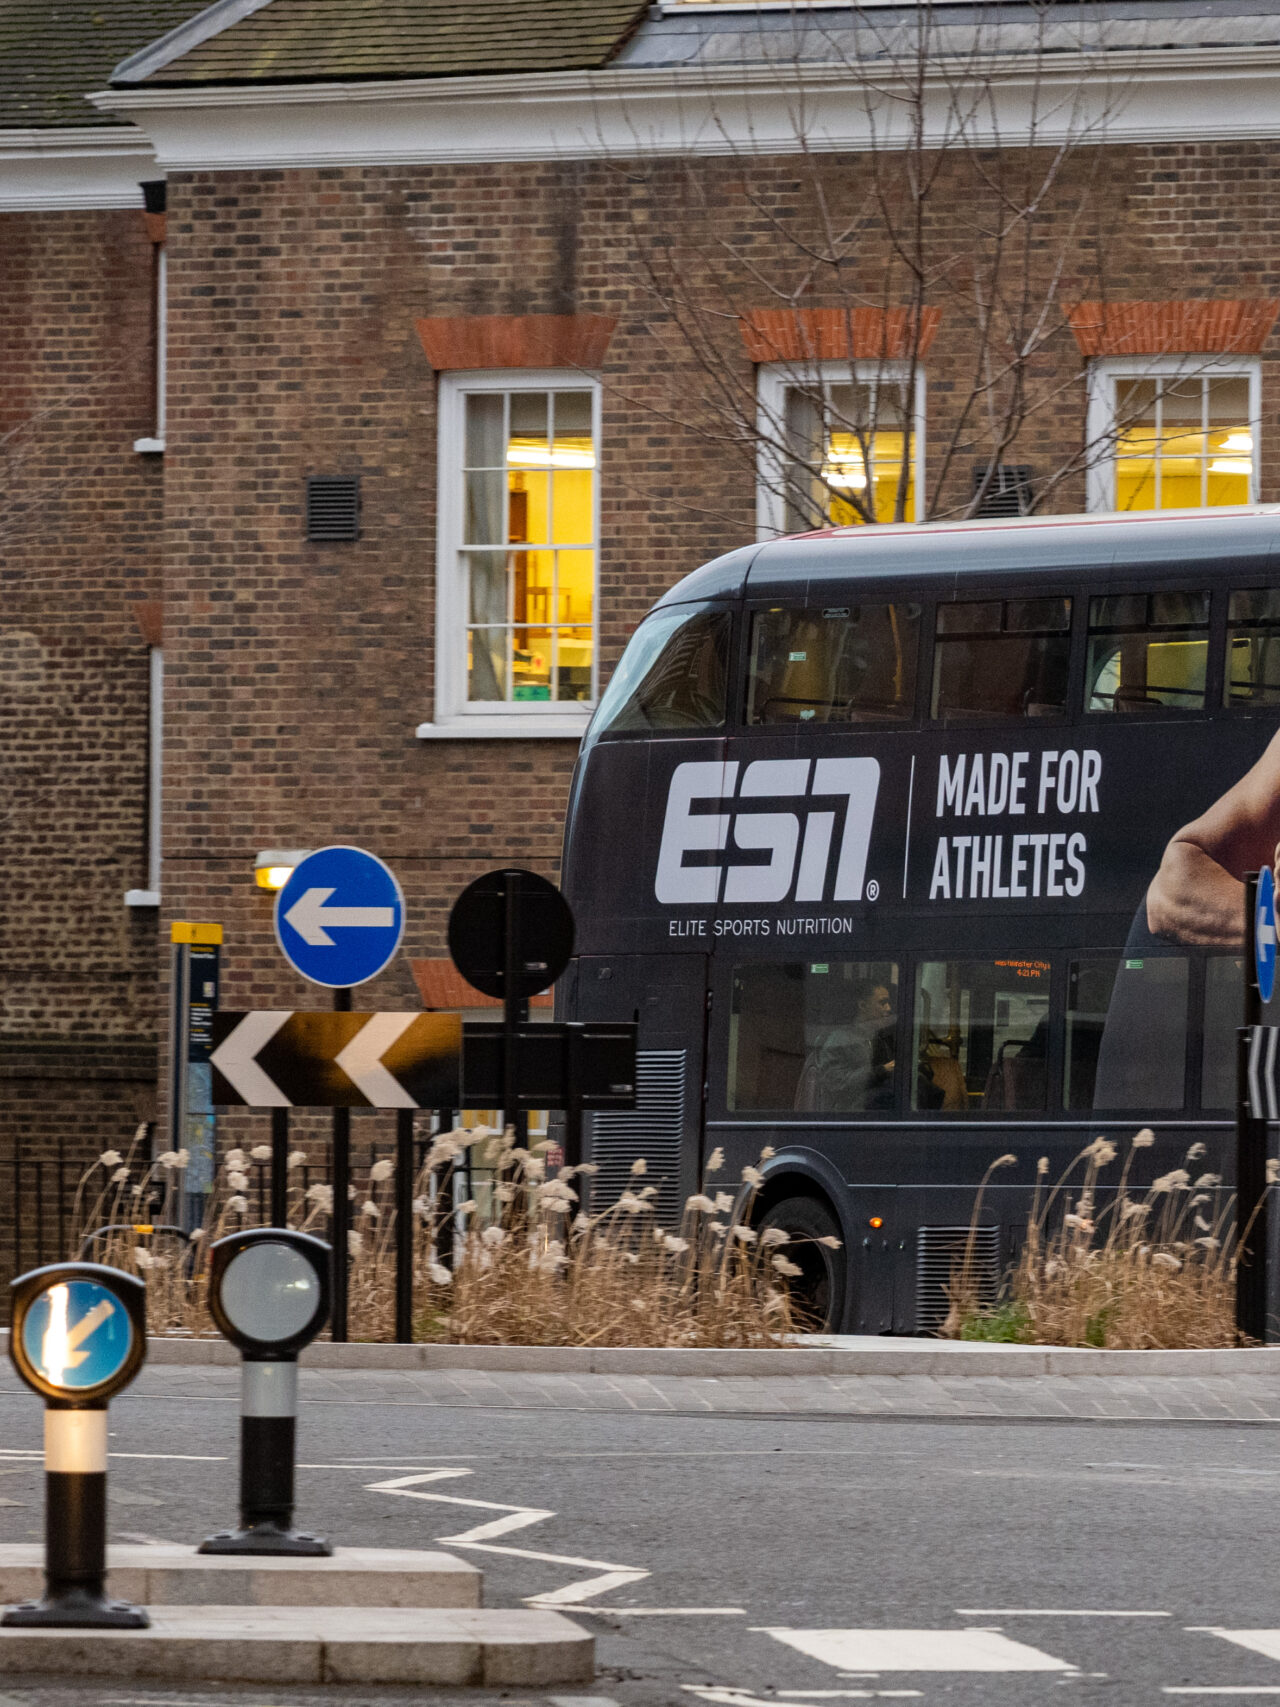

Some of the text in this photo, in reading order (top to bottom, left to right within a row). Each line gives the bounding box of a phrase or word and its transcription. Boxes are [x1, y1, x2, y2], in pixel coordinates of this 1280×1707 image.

[935, 749, 1102, 818] MADE FOR
[929, 832, 1087, 900] ATHLETES
[669, 917, 853, 936] ELITE SPORTS NUTRITION
